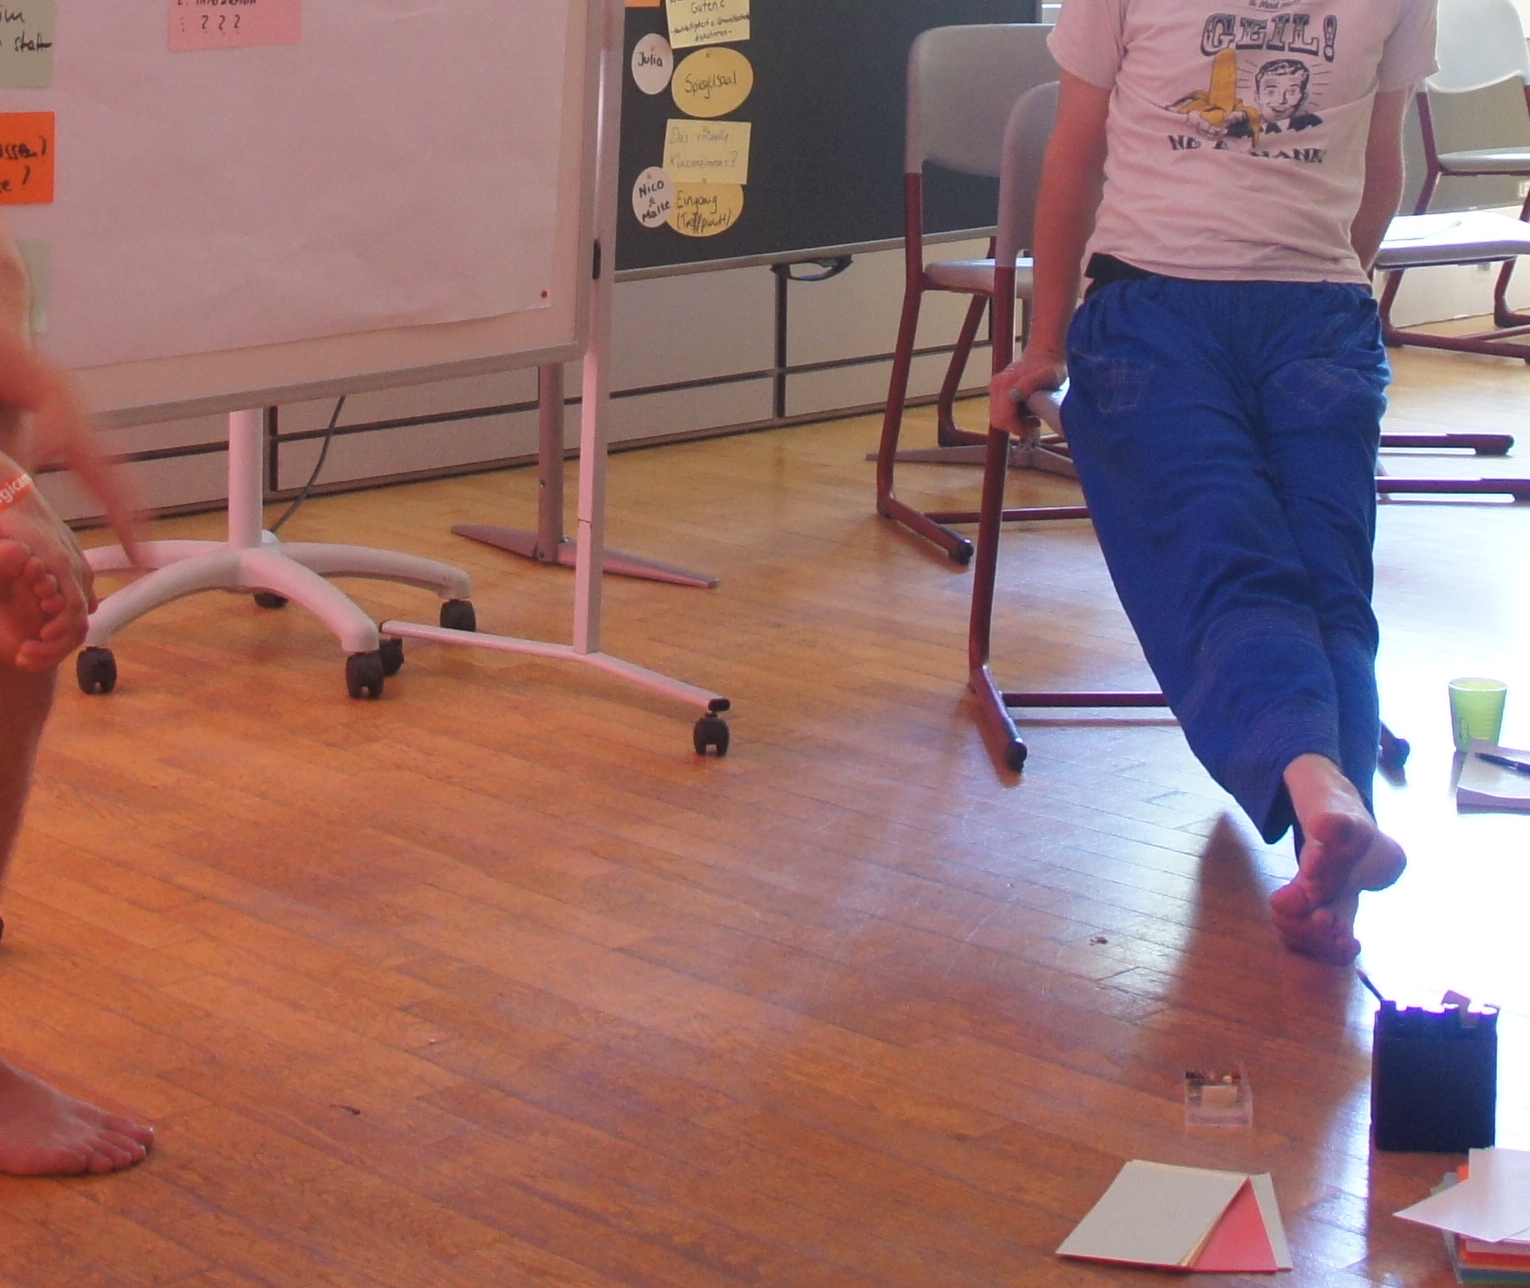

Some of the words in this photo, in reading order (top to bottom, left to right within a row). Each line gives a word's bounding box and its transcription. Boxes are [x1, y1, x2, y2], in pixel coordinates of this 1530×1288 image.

[1201, 13, 1337, 62] GEIL!
[638, 51, 663, 67] Julia
[639, 180, 664, 198] Nico
